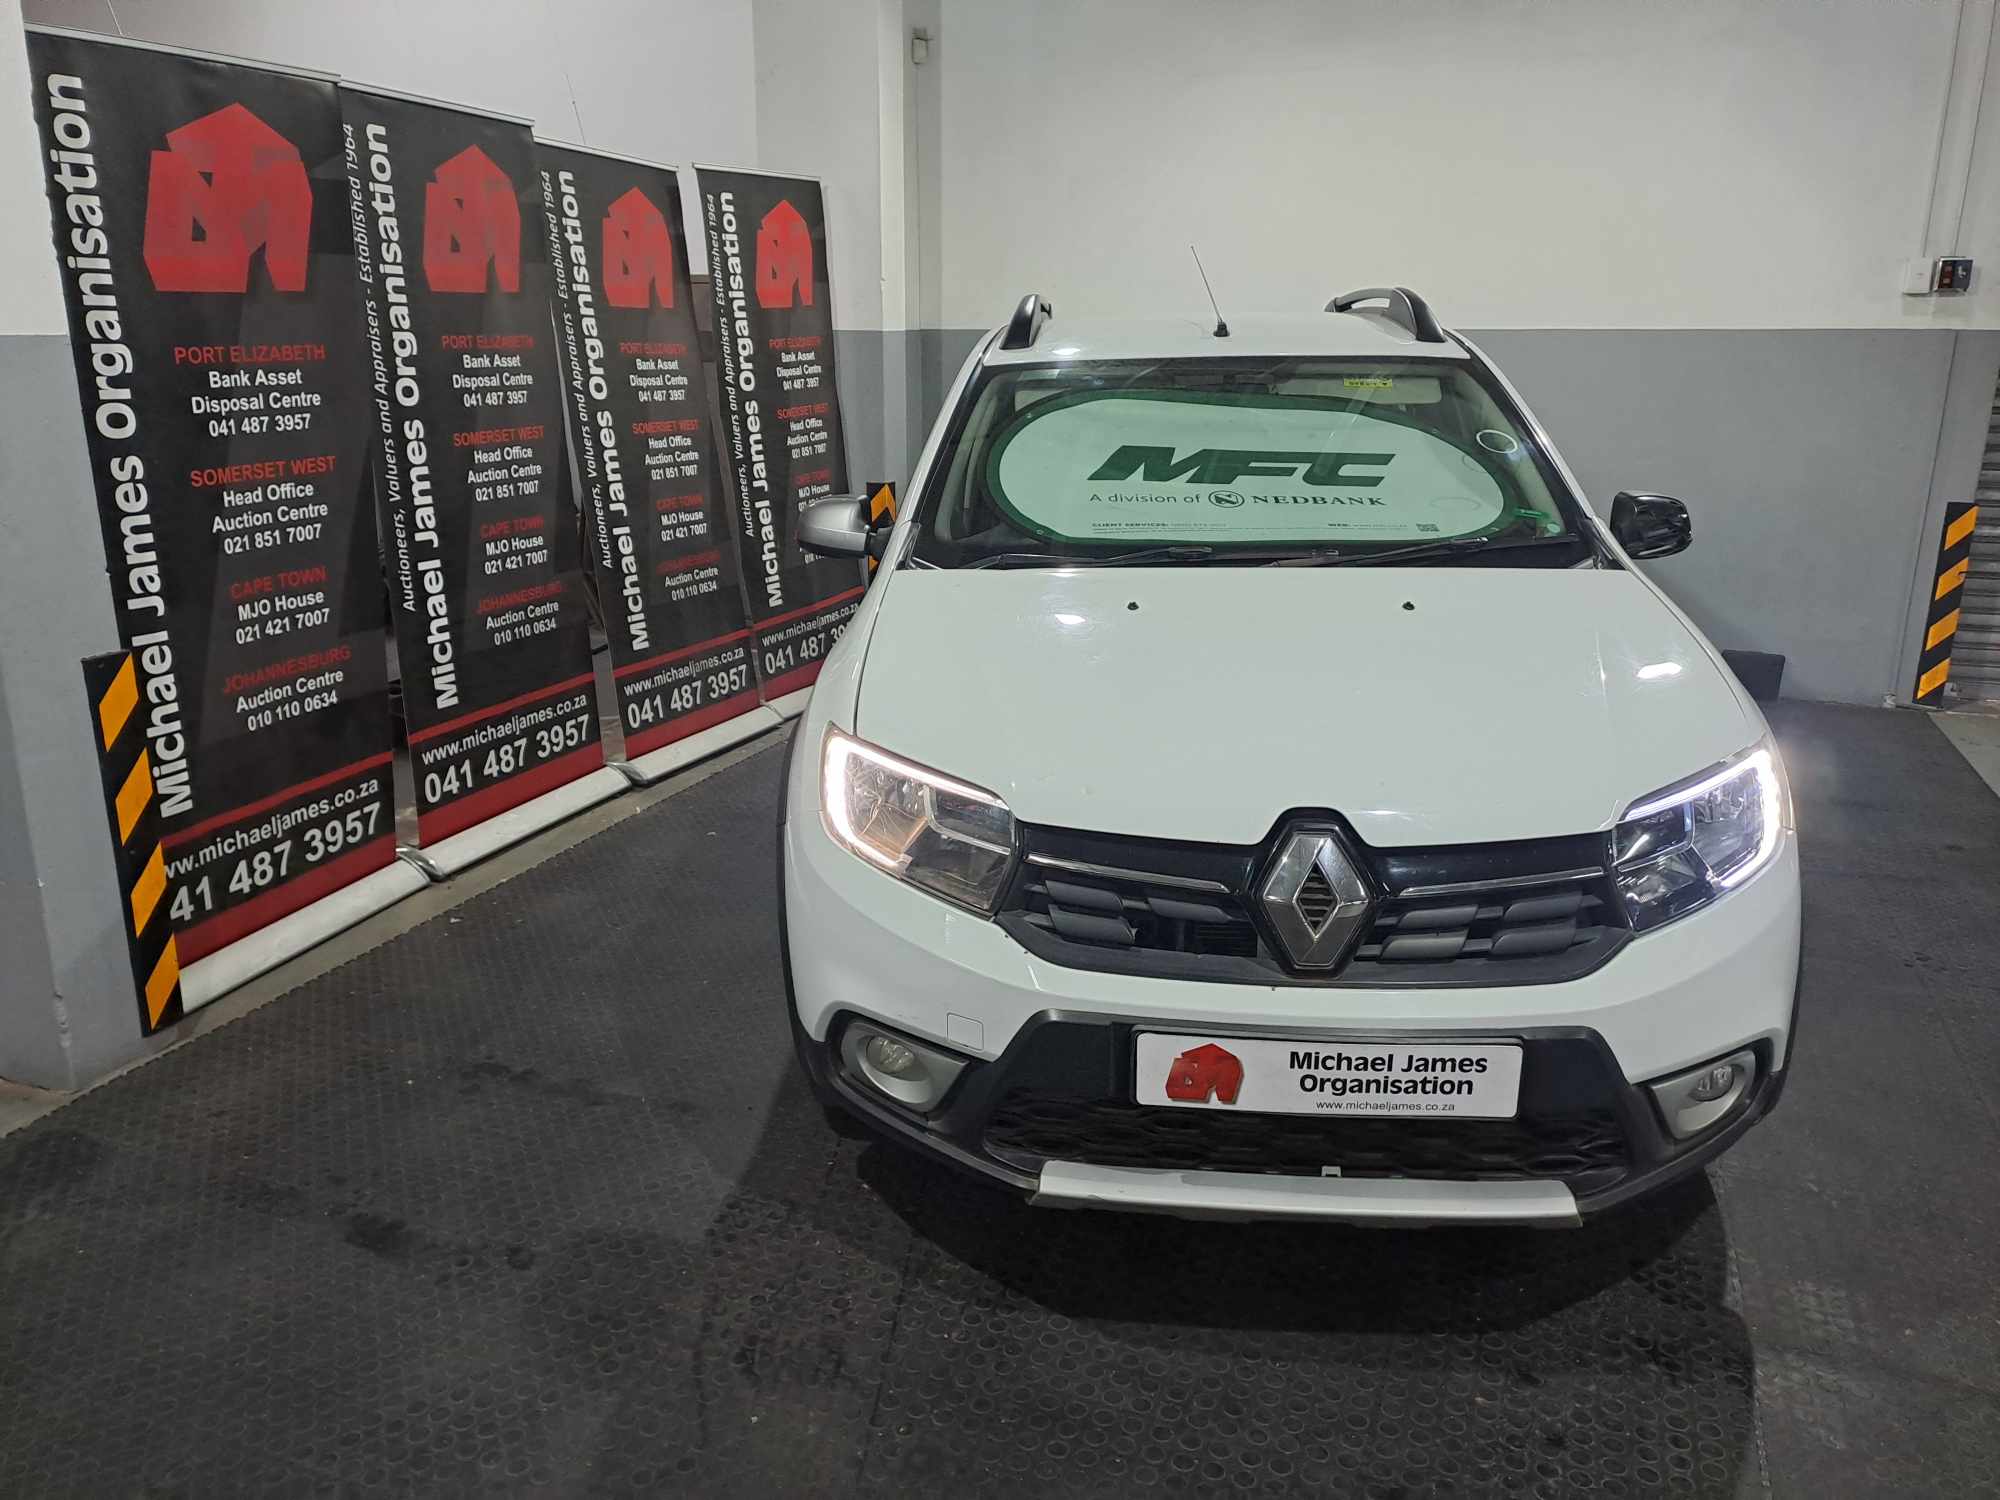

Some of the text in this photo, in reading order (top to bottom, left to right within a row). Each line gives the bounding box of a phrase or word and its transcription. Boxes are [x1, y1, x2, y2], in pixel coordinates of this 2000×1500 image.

[347, 176, 374, 285] Established
[548, 213, 569, 300] Established
[709, 230, 726, 306] Established
[174, 343, 326, 364] PORT ELIZABETH
[366, 299, 389, 396] Appraisers
[441, 335, 473, 349] PORT
[562, 311, 583, 391] Appraisers
[719, 316, 735, 384] Appraisers
[462, 353, 521, 369] Bank Asset
[635, 358, 679, 370] Bank Asset
[209, 368, 303, 389] Bank Asset
[452, 373, 533, 391] Disposal Centre
[629, 374, 688, 389] Disposal Centre
[191, 390, 321, 418] Disposal Centre
[463, 390, 528, 408] 041 487 3957
[558, 170, 650, 651] Michael James Organisation
[573, 392, 588, 421] and
[638, 390, 652, 402] 041
[653, 389, 667, 401] 487
[720, 191, 783, 608] Michael James Organisation
[725, 386, 738, 411] and
[208, 413, 312, 438] 041 487 3957
[366, 123, 460, 710] Michael James Organisation
[375, 399, 393, 434] and
[47, 73, 193, 818] Michael James Organisation
[453, 424, 545, 447] SOMERSET WEST
[648, 435, 692, 448] Head Office
[731, 414, 744, 460] Valuers
[473, 446, 533, 464] Head Office
[581, 425, 597, 478] Valuers
[645, 450, 699, 465] Auction Centre
[1086, 444, 1397, 487] MFC
[190, 456, 336, 488] SOMERSET WEST
[382, 438, 401, 503] Valuers
[467, 465, 542, 484] Auction Centre
[651, 468, 664, 480] 021
[665, 466, 679, 478] 851
[222, 482, 314, 508] Head Office
[475, 480, 540, 502] 021 851 7007
[1089, 491, 1386, 506] A division of NEDBANK
[211, 503, 329, 534] Auction Centre
[592, 484, 613, 569] Auctioneers,
[661, 511, 704, 526] MJO House
[661, 522, 708, 542] 021 421 7007
[224, 524, 322, 555] 021 851 7007
[485, 535, 544, 556] MJO House
[393, 508, 416, 612] Auctioneers,
[484, 549, 548, 576] 021 421 7007
[229, 566, 327, 599] CAPE TOWN
[664, 567, 719, 587] Auction Centre
[671, 580, 718, 601] 010 110 0634
[237, 590, 325, 621] MJO House
[485, 601, 559, 631] Auction Centre
[235, 608, 330, 645] 021 421 7007
[494, 618, 557, 646] 010 110 0634
[765, 645, 795, 674] 041
[800, 632, 826, 660] 487
[222, 645, 351, 694] JOHANNESBURG
[623, 646, 745, 697] www.michaeljames.co.za
[235, 670, 344, 713] Auction Centre
[627, 664, 747, 729] 041 487 3957
[246, 690, 338, 732] 010 110 0634
[421, 694, 587, 766] www.michaeljames.co.za
[424, 713, 590, 804] 041 487 3957
[169, 802, 381, 921] 41 487 3957
[1289, 1050, 1488, 1074] Michael James
[1299, 1073, 1474, 1098] Organisation
[1315, 1100, 1456, 1113] www.michaeljames.co.za
